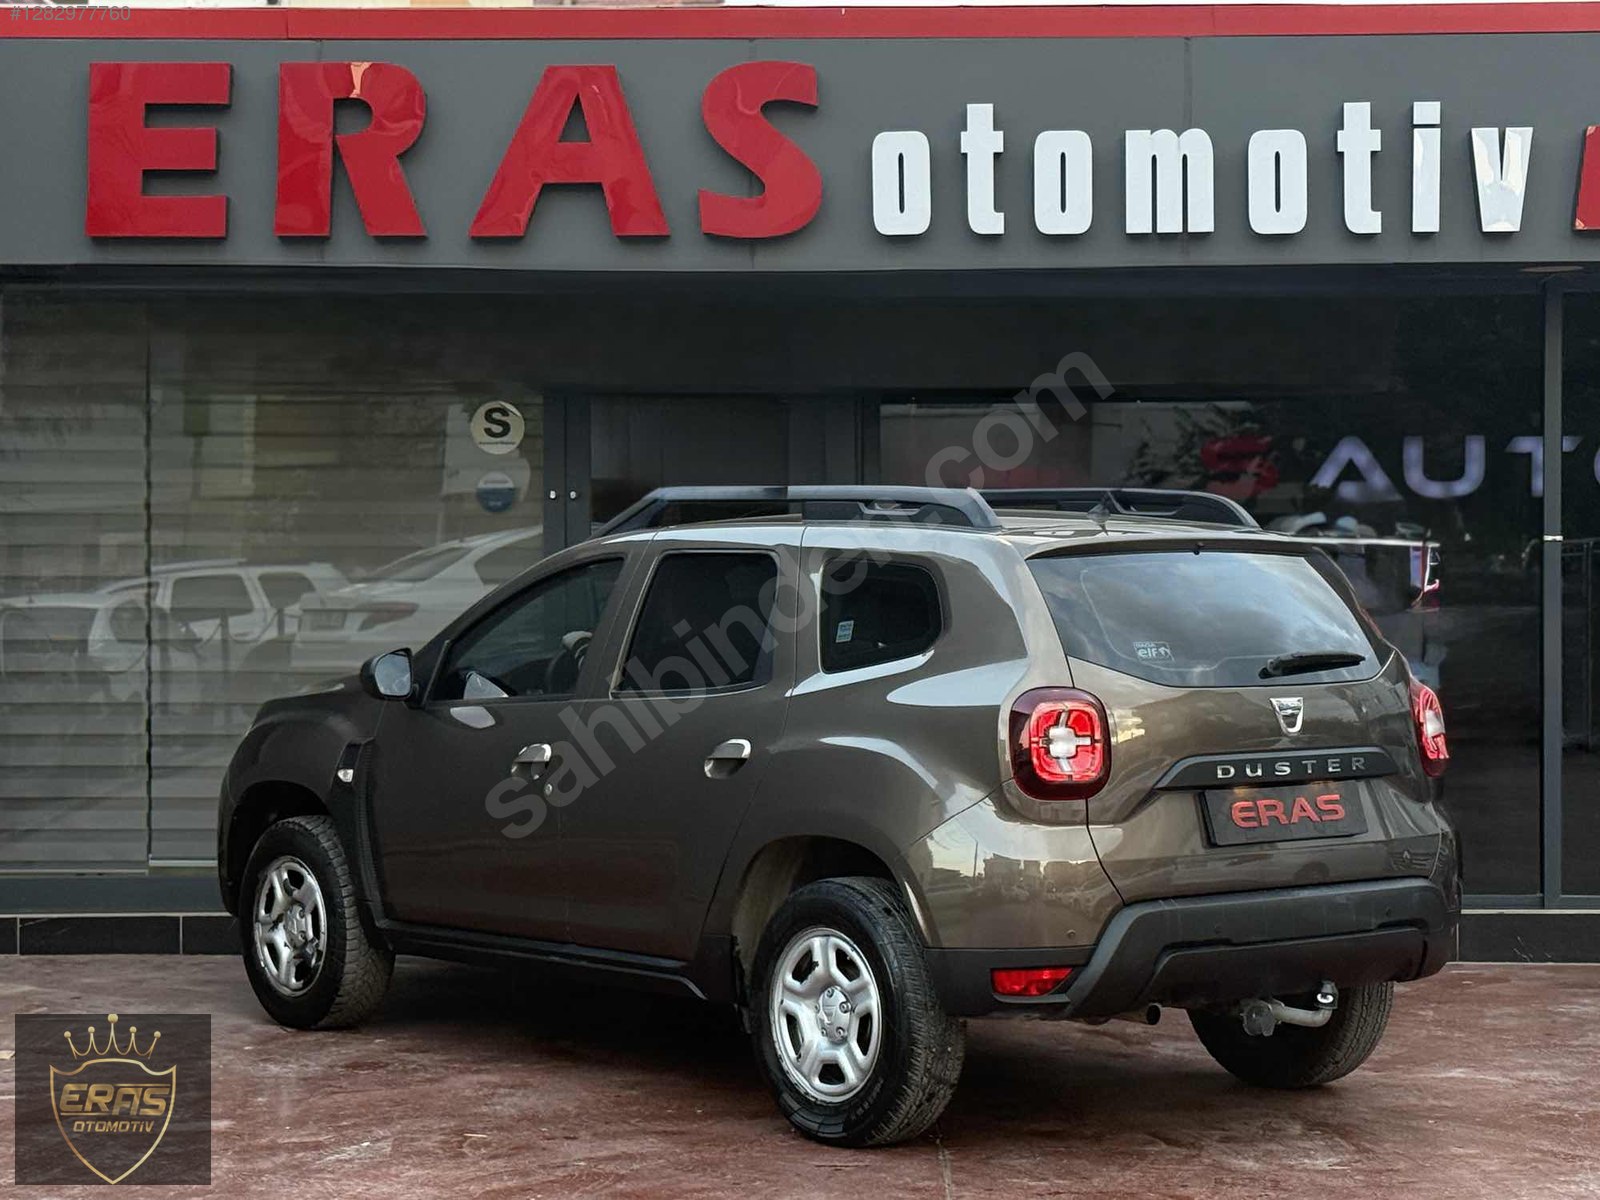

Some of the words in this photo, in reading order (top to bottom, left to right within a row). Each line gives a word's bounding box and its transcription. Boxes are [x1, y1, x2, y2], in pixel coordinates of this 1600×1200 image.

[85, 60, 823, 240] ERAS
[871, 101, 1534, 236] otomotiv
[483, 407, 511, 438] S
[1217, 757, 1366, 779] DUSTER
[1231, 793, 1346, 828] ERAS
